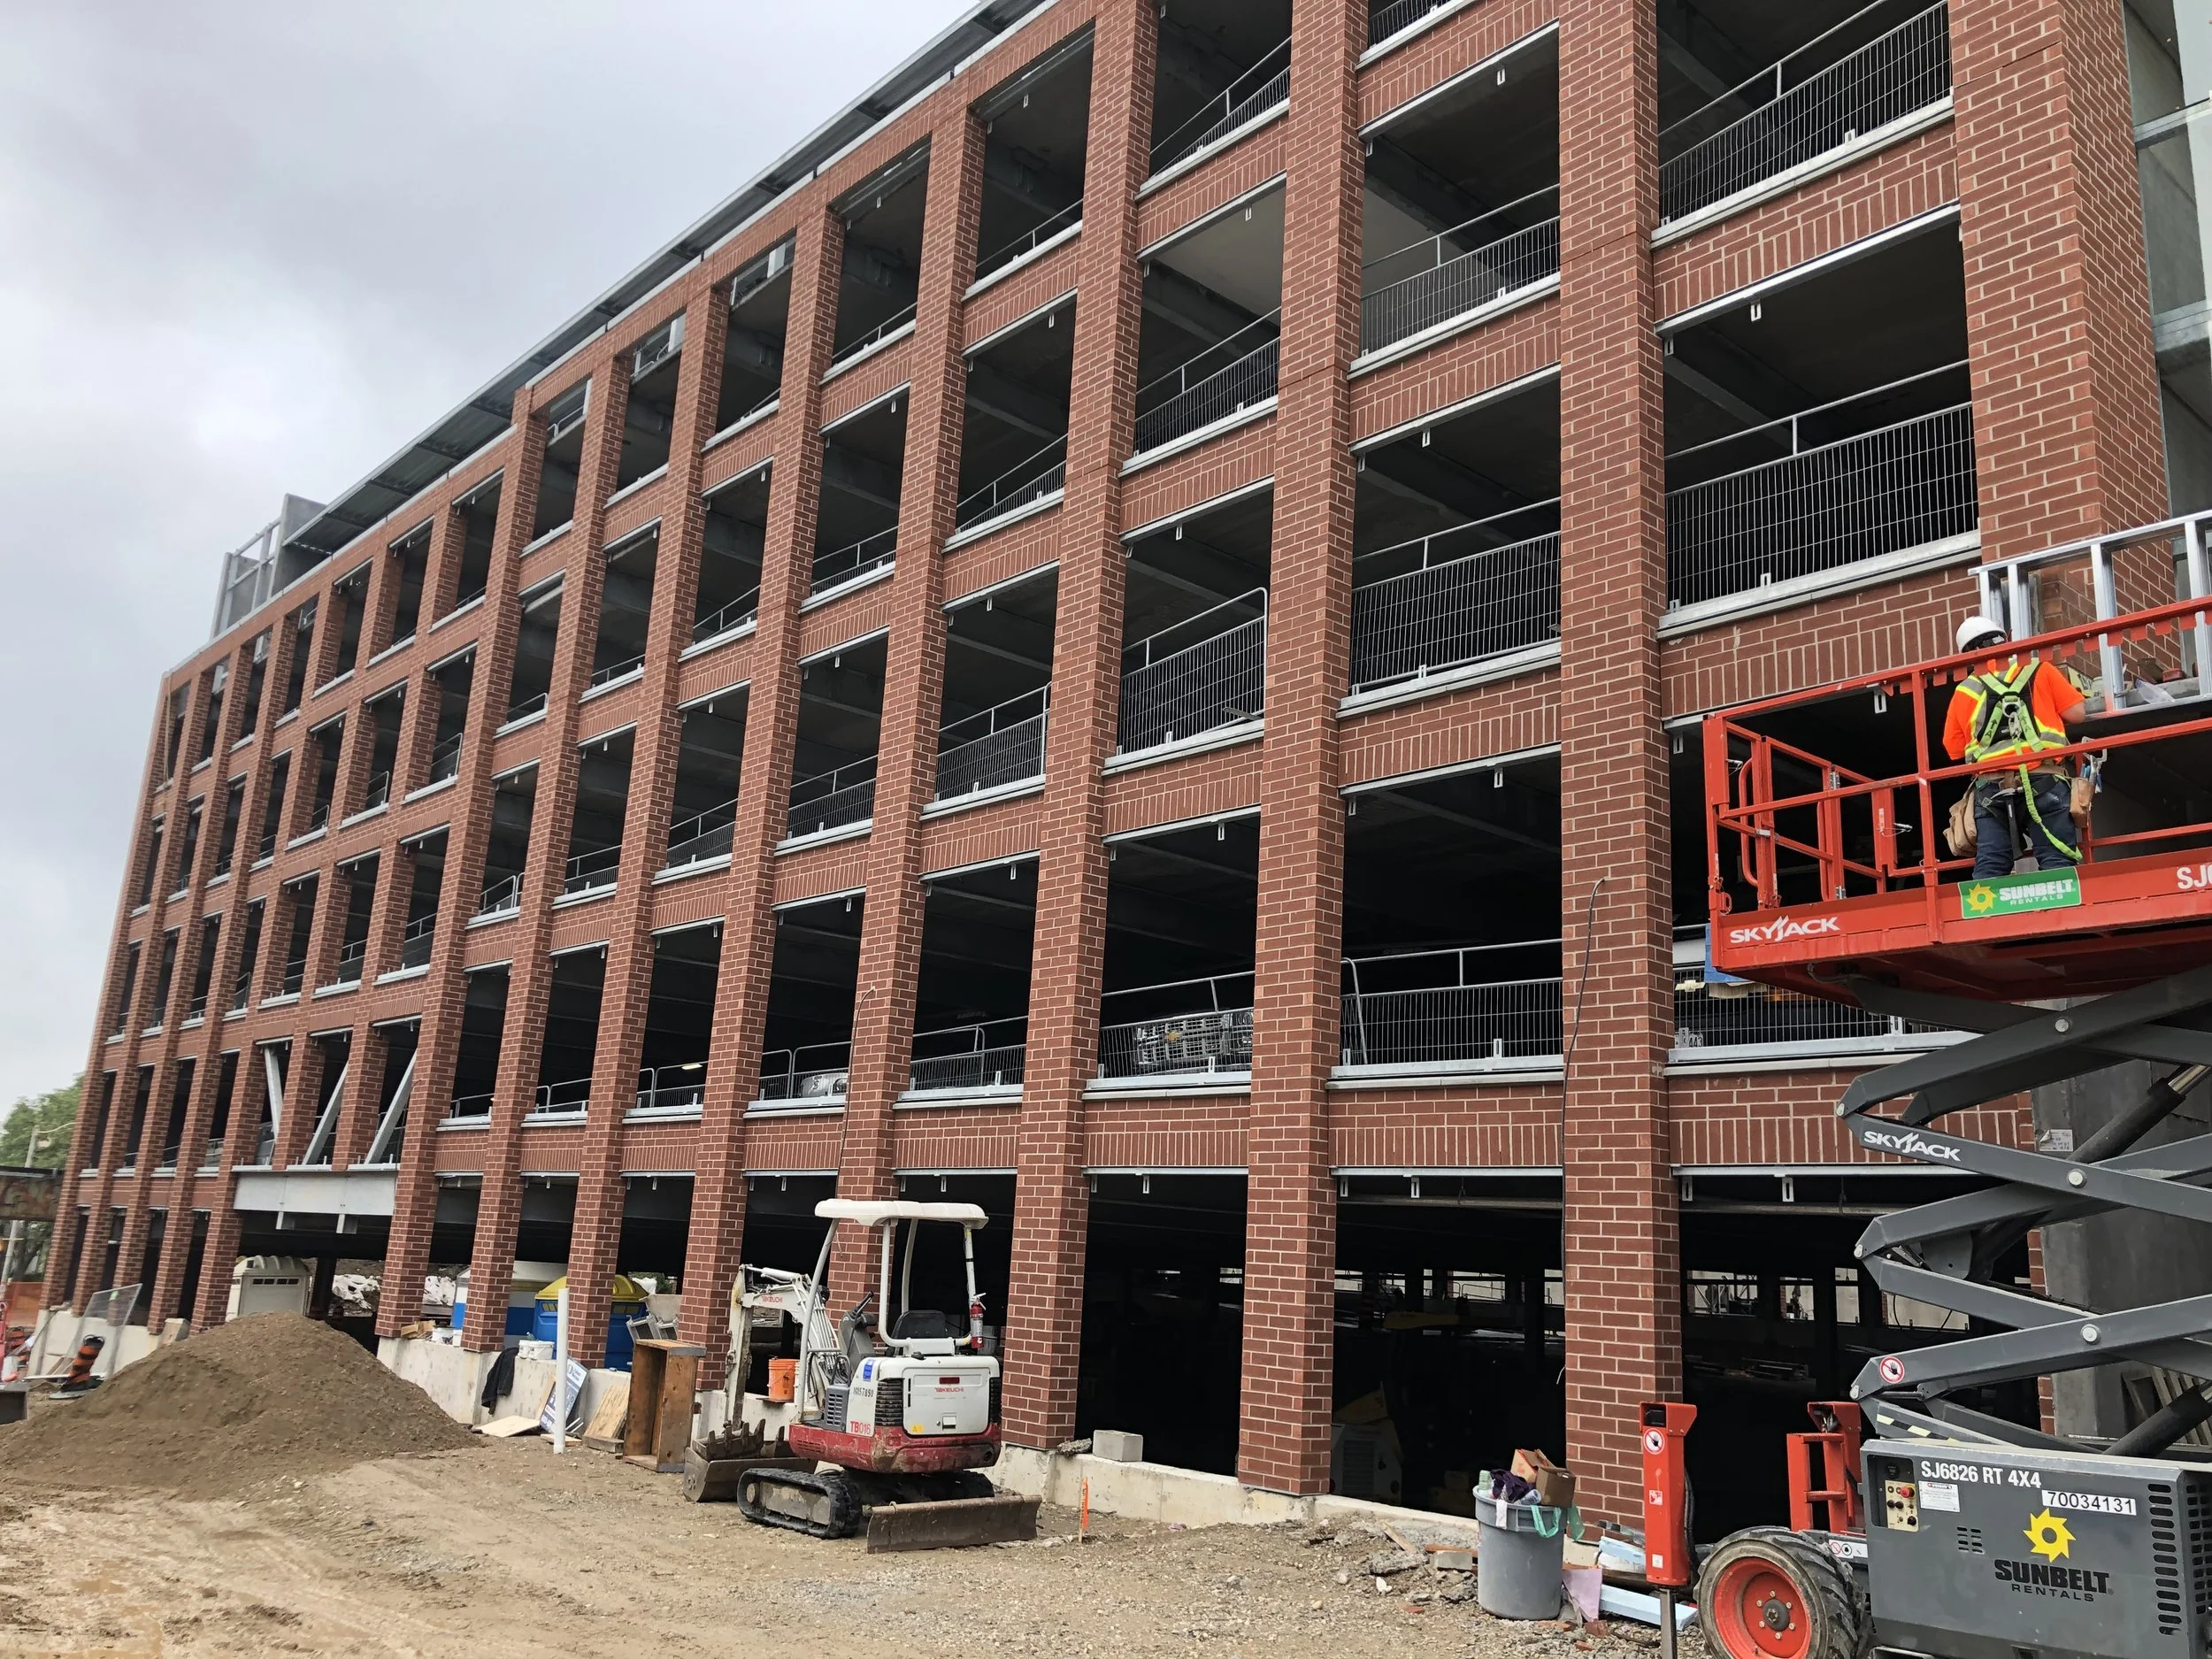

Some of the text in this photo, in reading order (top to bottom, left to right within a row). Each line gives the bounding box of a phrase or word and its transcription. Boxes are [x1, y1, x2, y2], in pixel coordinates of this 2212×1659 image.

[1999, 879, 2074, 902] SUNBELT
[2009, 894, 2064, 906] RENTALS
[1730, 915, 1840, 944] SKYJACK
[1863, 1131, 1962, 1162] SKYJACK
[849, 1420, 872, 1435] TB016
[1921, 1460, 2042, 1489] SJ6826 RT 4X4
[2047, 1492, 2134, 1514] 70034131
[1994, 1559, 2110, 1594] SUNBELT
[2011, 1583, 2094, 1602] RENTALS
